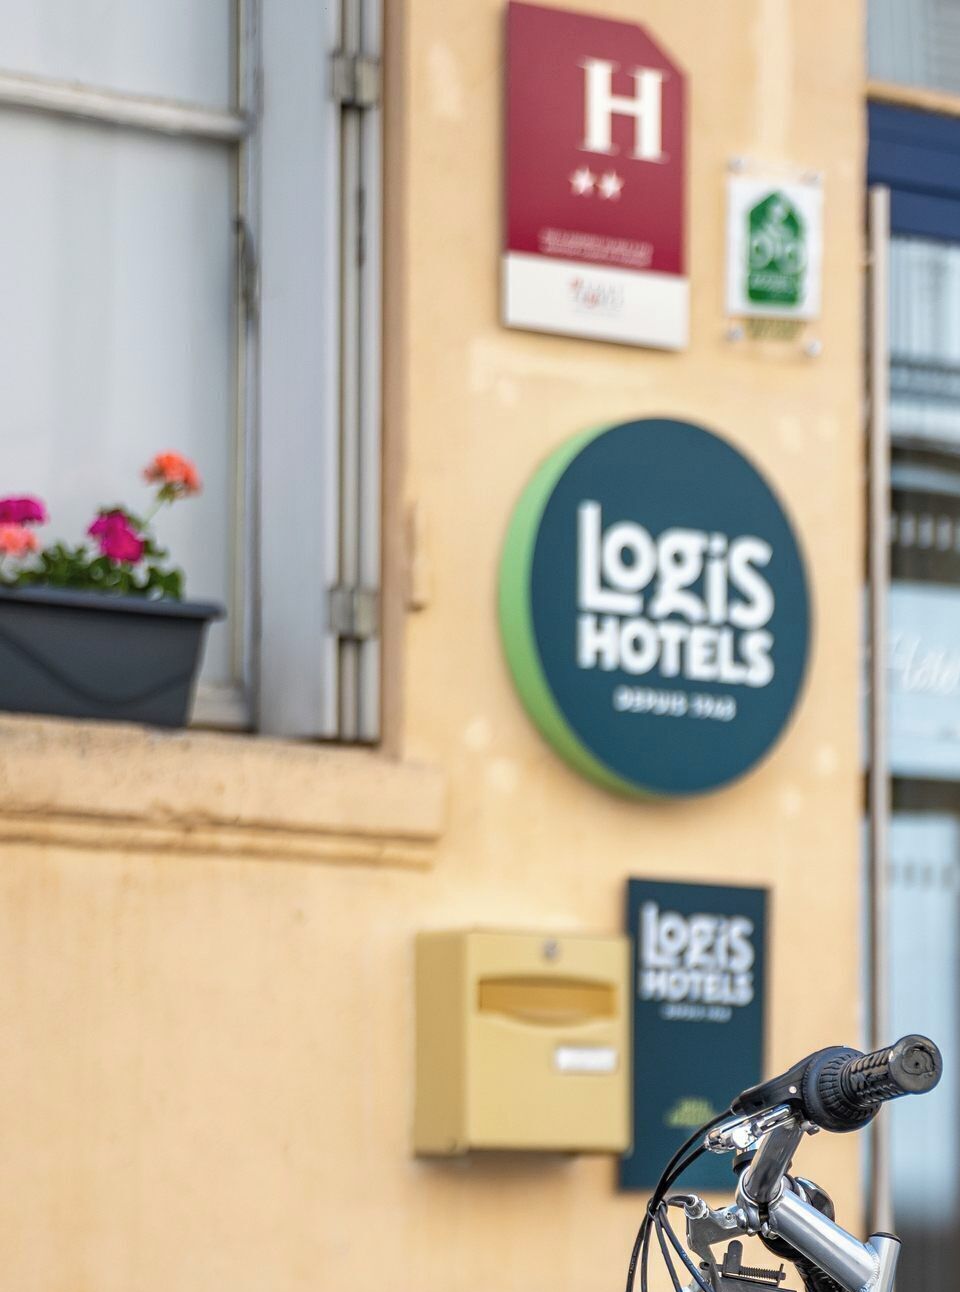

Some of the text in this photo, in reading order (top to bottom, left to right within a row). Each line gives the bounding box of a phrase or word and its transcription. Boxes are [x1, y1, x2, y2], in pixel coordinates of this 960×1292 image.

[582, 57, 666, 164] H
[577, 615, 774, 687] HOTELS
[639, 967, 754, 1006] HOTELS
